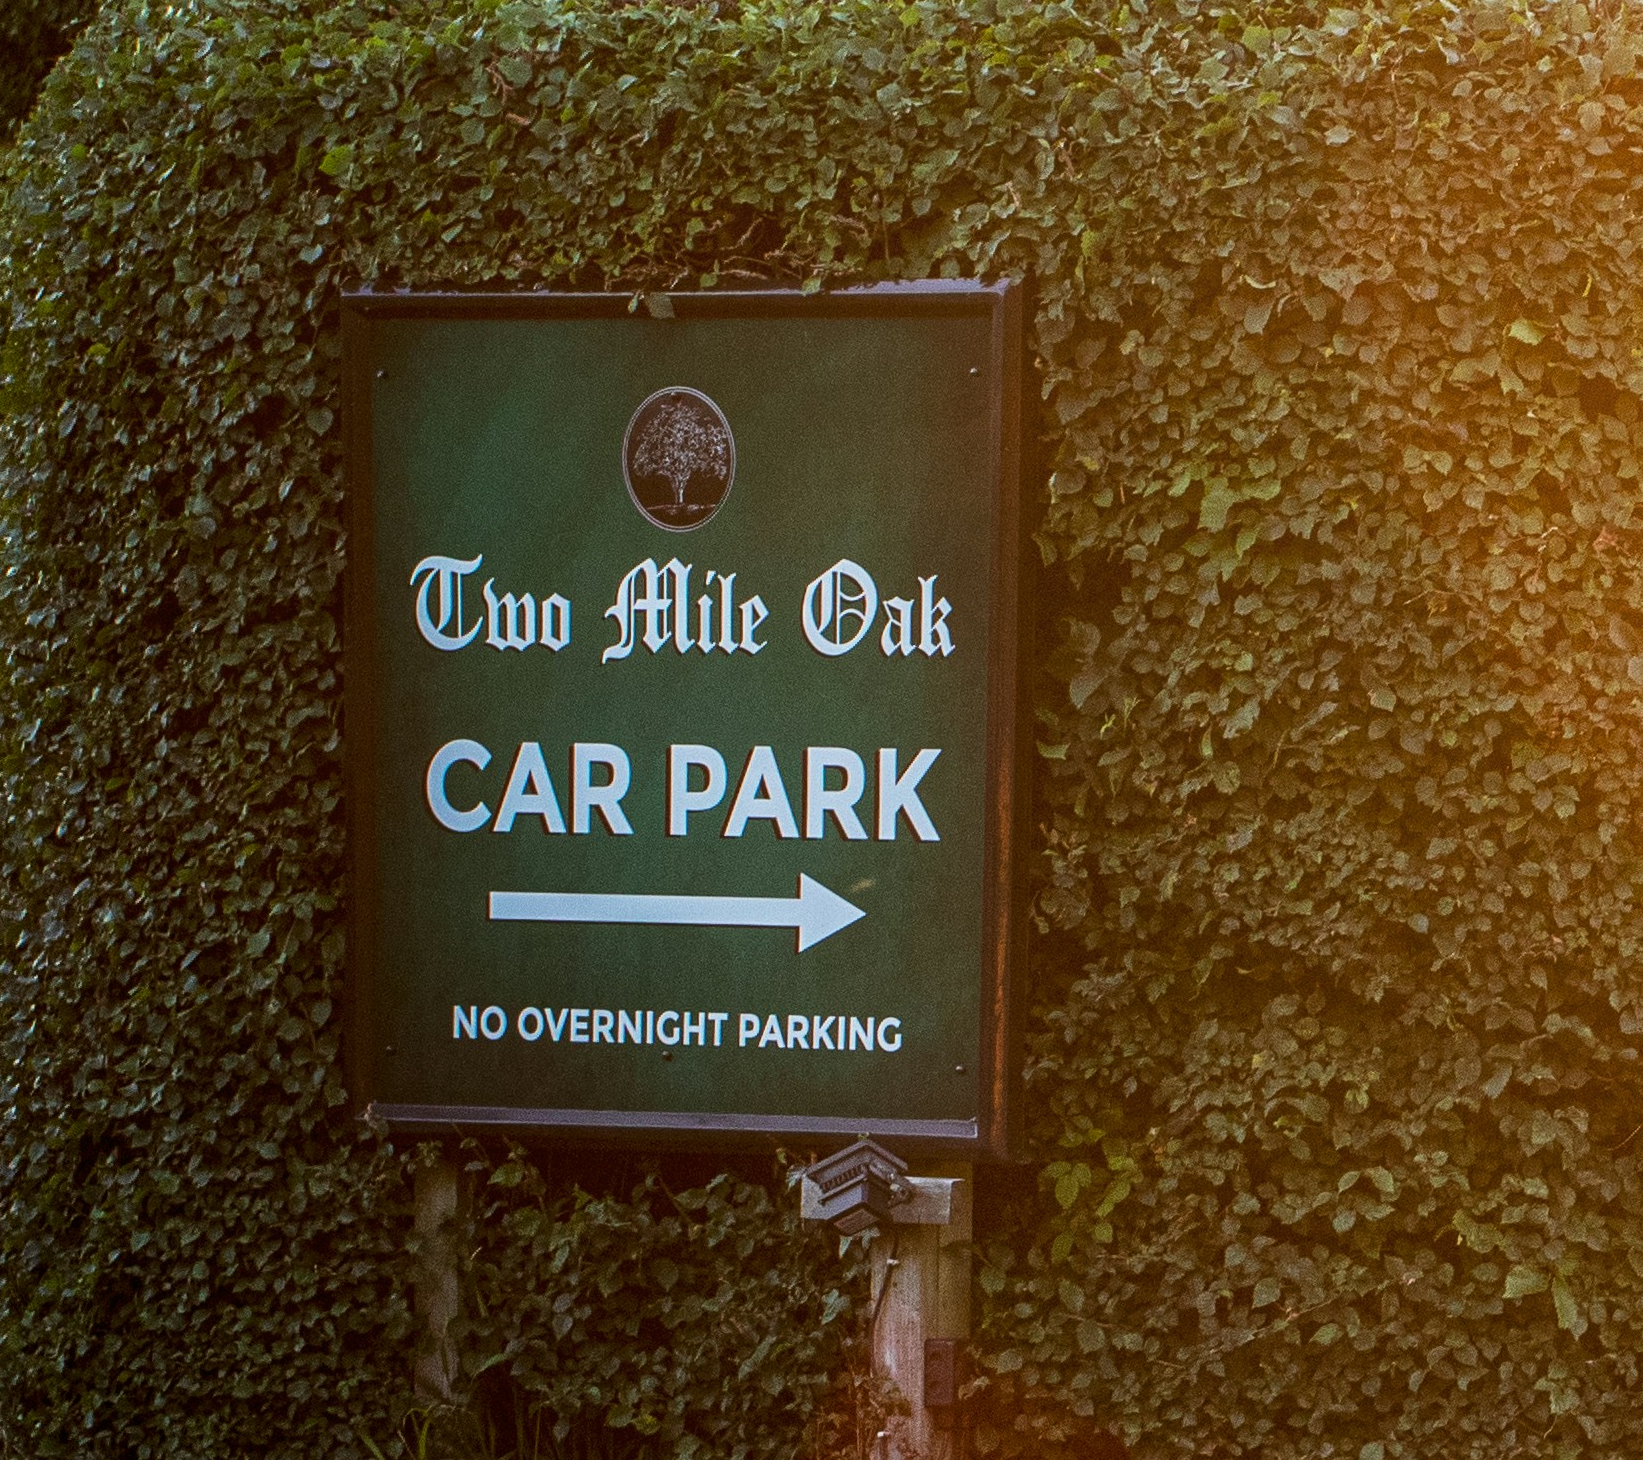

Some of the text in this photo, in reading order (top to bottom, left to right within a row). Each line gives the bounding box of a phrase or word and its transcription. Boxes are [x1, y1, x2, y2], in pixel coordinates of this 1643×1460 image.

[409, 553, 956, 665] Two Mile Oak
[426, 738, 943, 842] CAR PARK
[453, 1005, 903, 1053] NO OVERNIGHT PARKING
